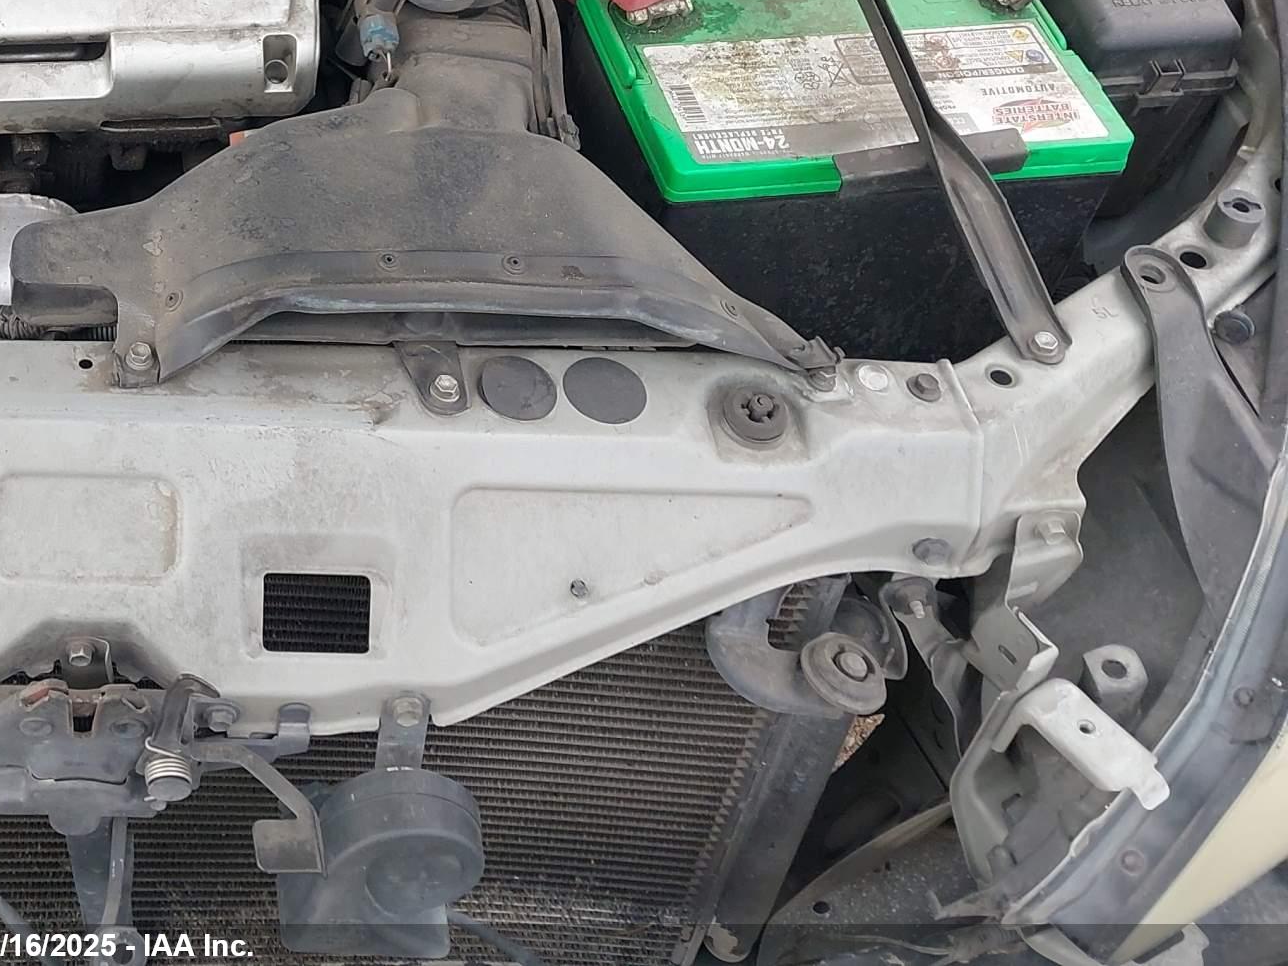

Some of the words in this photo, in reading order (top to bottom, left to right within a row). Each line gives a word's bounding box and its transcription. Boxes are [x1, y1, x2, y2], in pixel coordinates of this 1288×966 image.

[982, 83, 1055, 96] AUTOMOTIVE
[995, 102, 1069, 116] BATTERIES
[996, 110, 1079, 124] INTERSTATE
[694, 135, 790, 154] 24-MONTH
